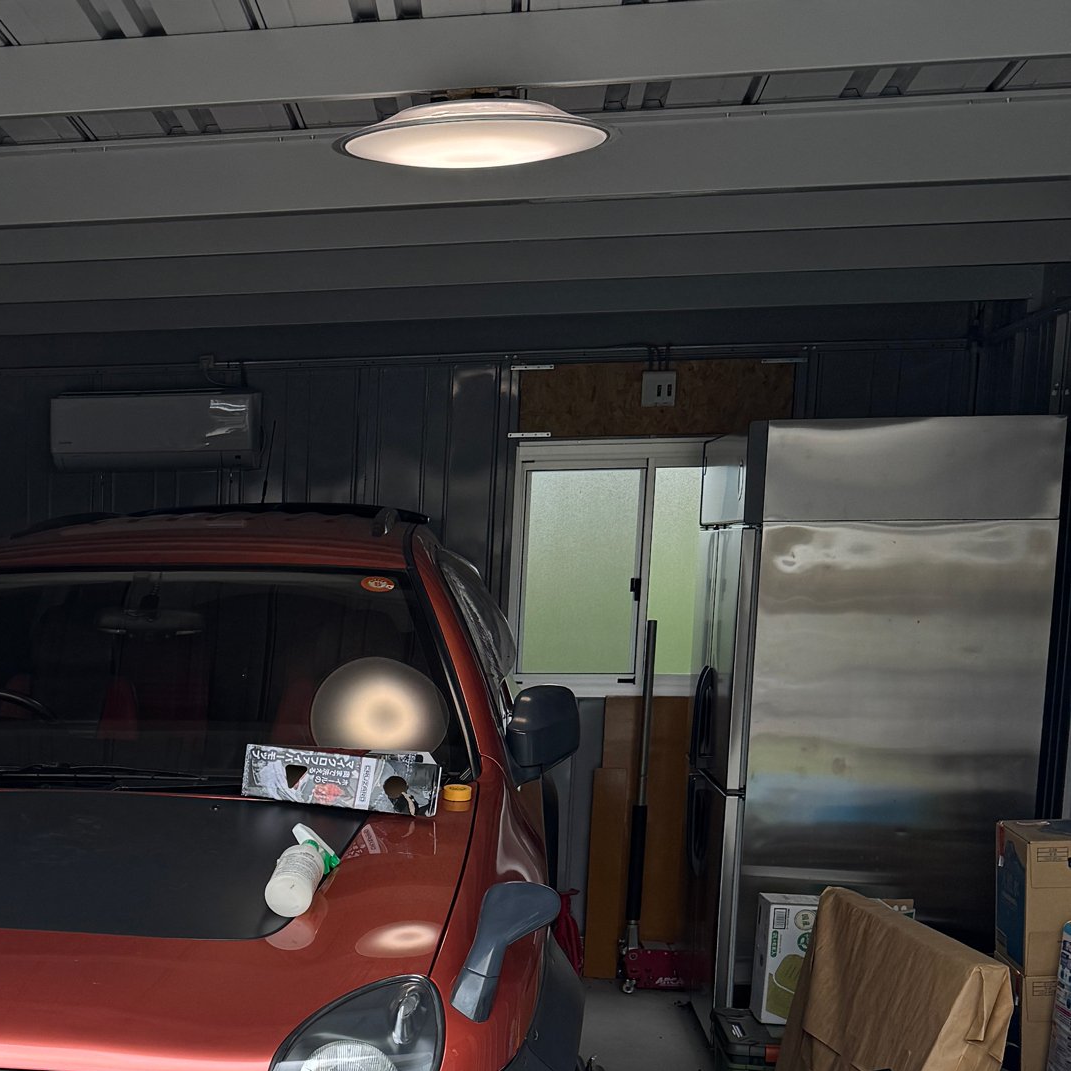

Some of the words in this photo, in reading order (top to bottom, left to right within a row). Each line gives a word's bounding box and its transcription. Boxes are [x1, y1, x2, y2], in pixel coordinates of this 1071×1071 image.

[252, 750, 354, 768] マイクロファイバーモップ
[655, 976, 684, 985] ARCA
